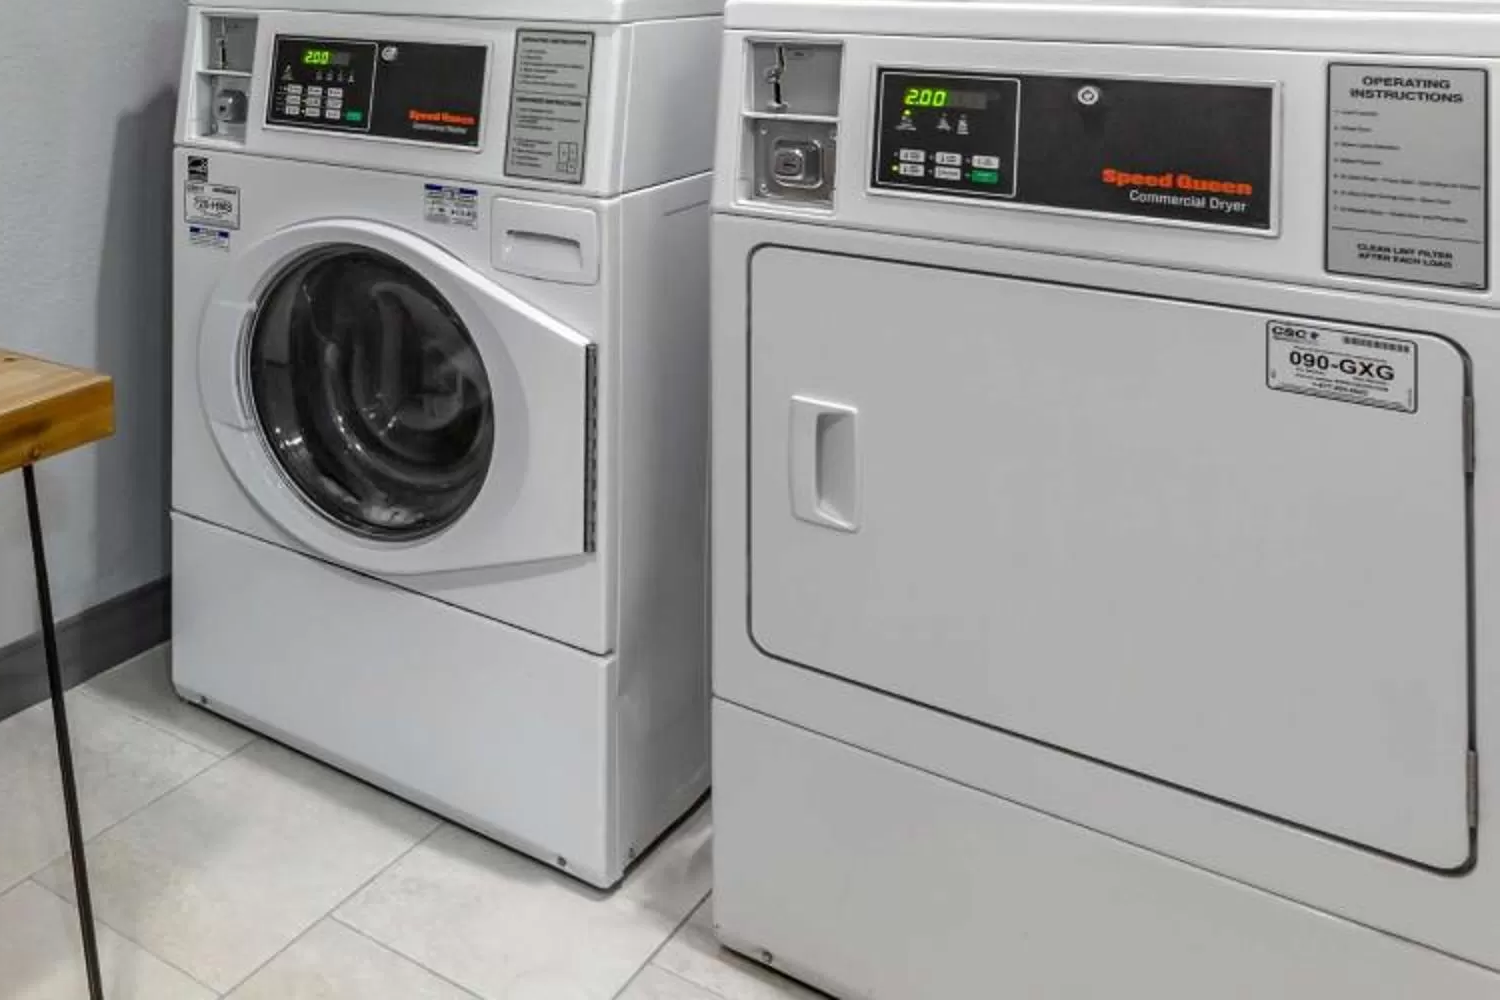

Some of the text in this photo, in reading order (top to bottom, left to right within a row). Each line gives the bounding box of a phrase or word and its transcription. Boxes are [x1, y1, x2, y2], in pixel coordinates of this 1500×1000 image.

[1361, 75, 1451, 89] OPERATING
[904, 88, 947, 107] 2.00
[1350, 87, 1464, 104] INSTRUCTIONS
[1102, 168, 1253, 196] Speed Queen
[1129, 189, 1248, 213] Commercial Dryer
[1289, 351, 1395, 381] 090-GXG
